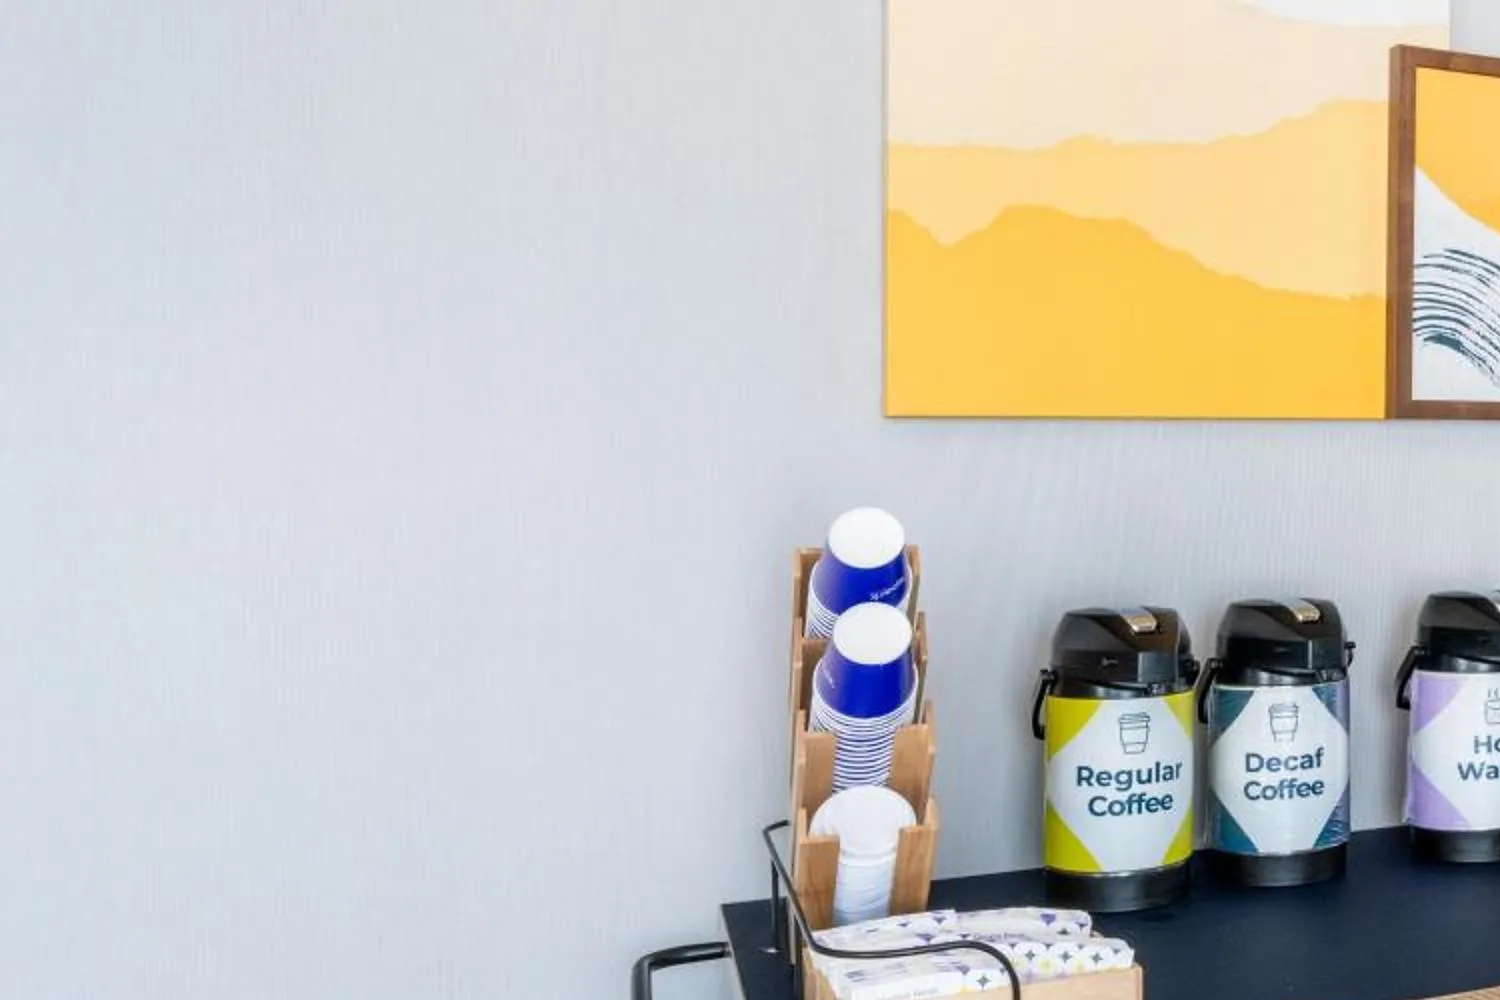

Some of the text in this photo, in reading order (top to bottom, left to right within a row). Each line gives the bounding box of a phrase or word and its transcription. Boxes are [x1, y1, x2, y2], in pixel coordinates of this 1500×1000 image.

[1245, 746, 1325, 773] Decaf
[1076, 761, 1182, 792] Regular
[1243, 777, 1325, 801] Coffee
[1087, 792, 1174, 817] Coffee
